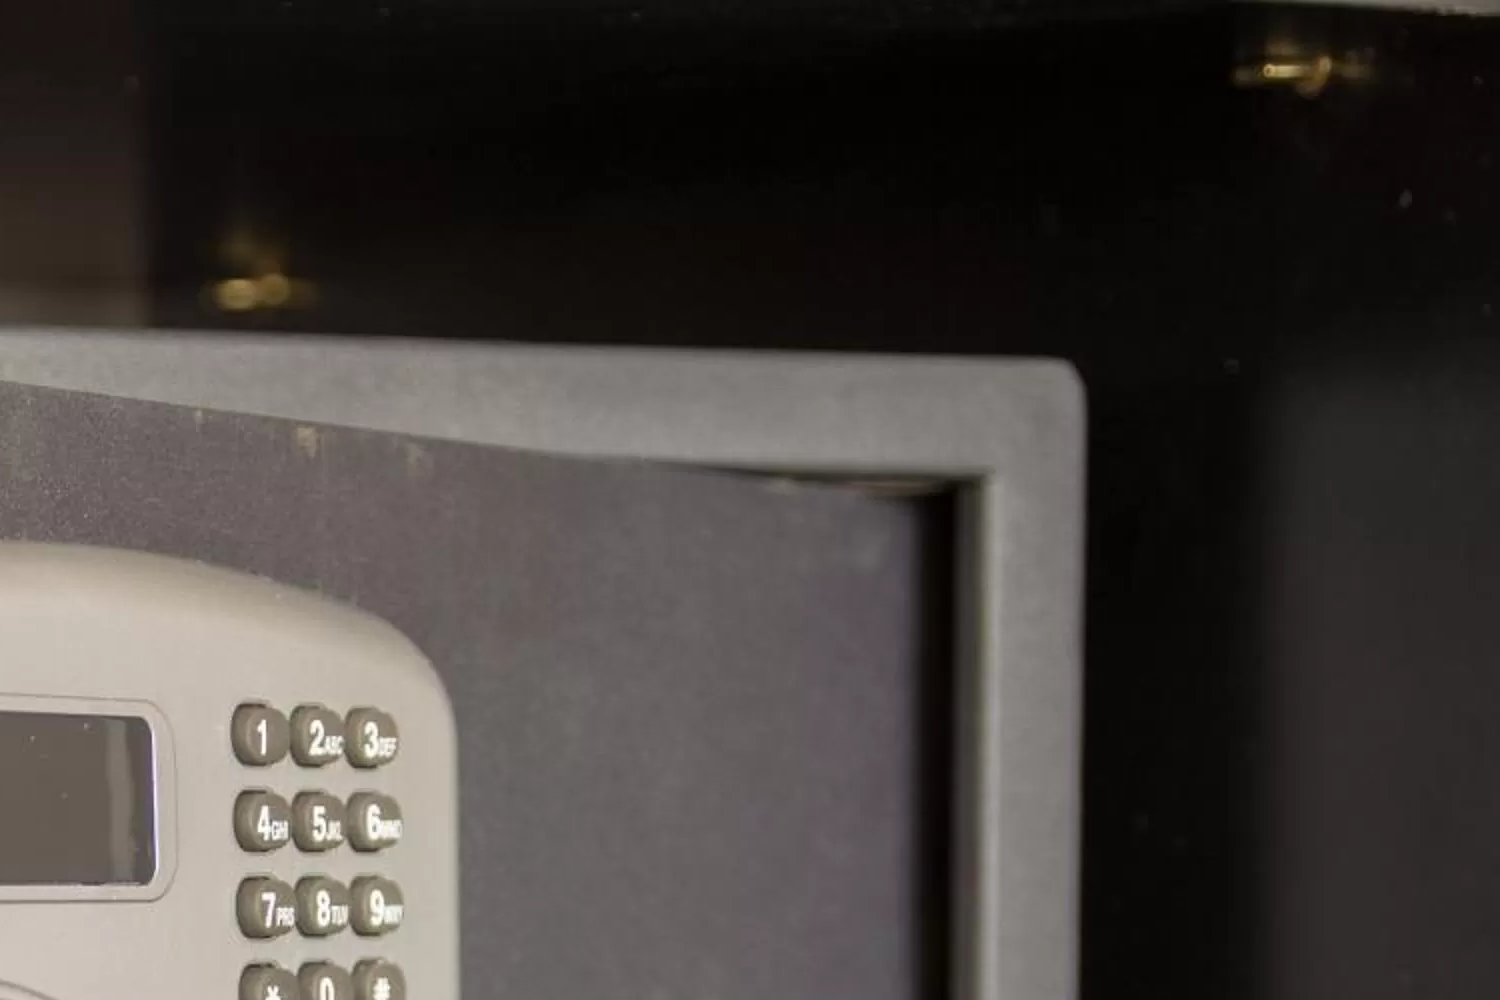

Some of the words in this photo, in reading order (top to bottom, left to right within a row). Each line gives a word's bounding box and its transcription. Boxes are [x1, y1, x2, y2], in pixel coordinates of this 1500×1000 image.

[257, 719, 267, 755] 1
[308, 719, 325, 756] 2
[364, 721, 379, 758] 3
[257, 805, 270, 841] 4
[312, 805, 326, 841] 5
[367, 804, 381, 840] 6
[261, 892, 276, 928] 7
[316, 889, 330, 927] 8
[370, 889, 384, 926] 9
